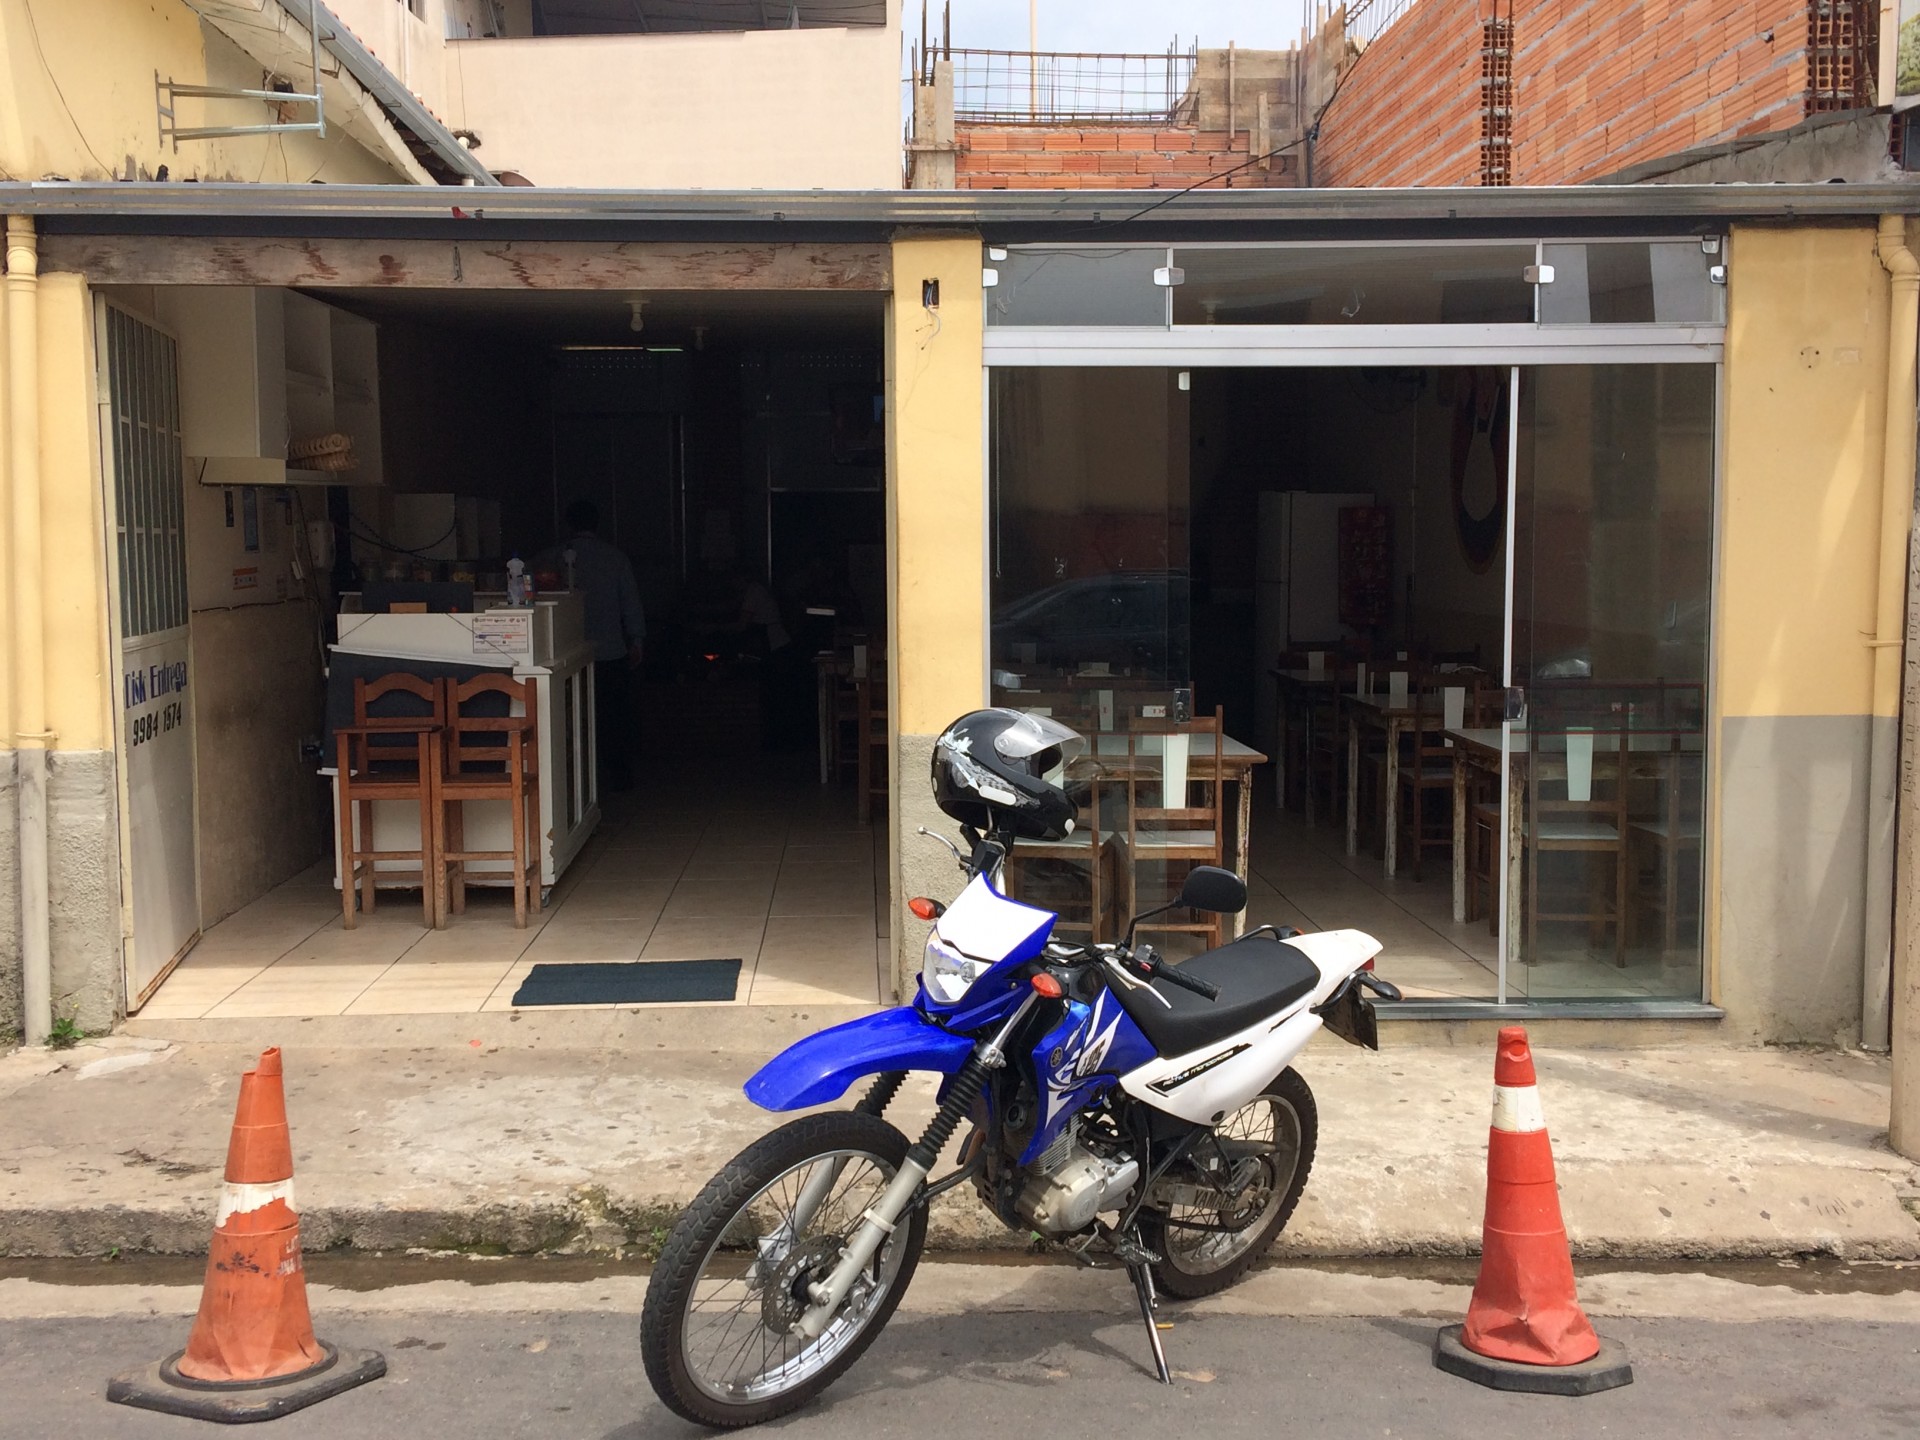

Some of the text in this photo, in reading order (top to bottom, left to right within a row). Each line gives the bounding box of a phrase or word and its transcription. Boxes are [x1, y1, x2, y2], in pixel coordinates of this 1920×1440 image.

[133, 701, 182, 747] 9984 1574
[1193, 1189, 1236, 1211] YAMAHA
